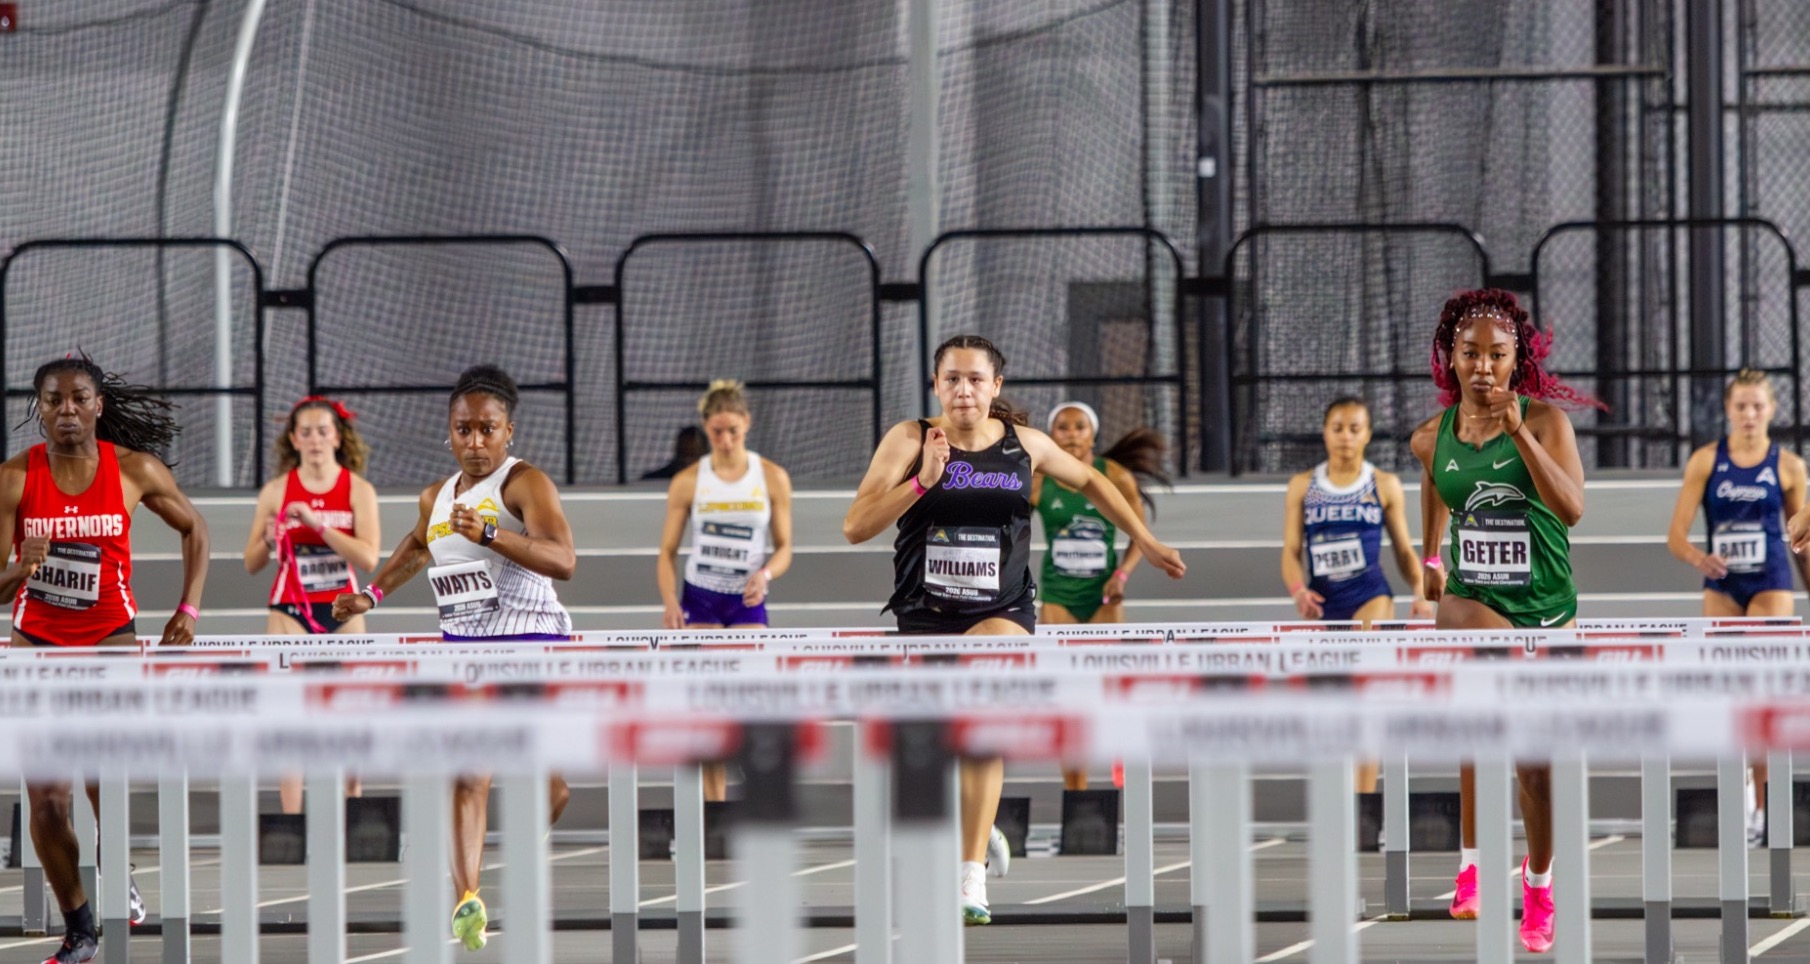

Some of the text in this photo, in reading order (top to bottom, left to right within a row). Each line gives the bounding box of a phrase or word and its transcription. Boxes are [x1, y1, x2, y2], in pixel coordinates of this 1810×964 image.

[942, 461, 1022, 490] Bears
[24, 514, 122, 539] GOVERNORS
[1463, 539, 1526, 565] GETER
[928, 559, 996, 577] WILLIAMS
[432, 570, 492, 597] WATTS
